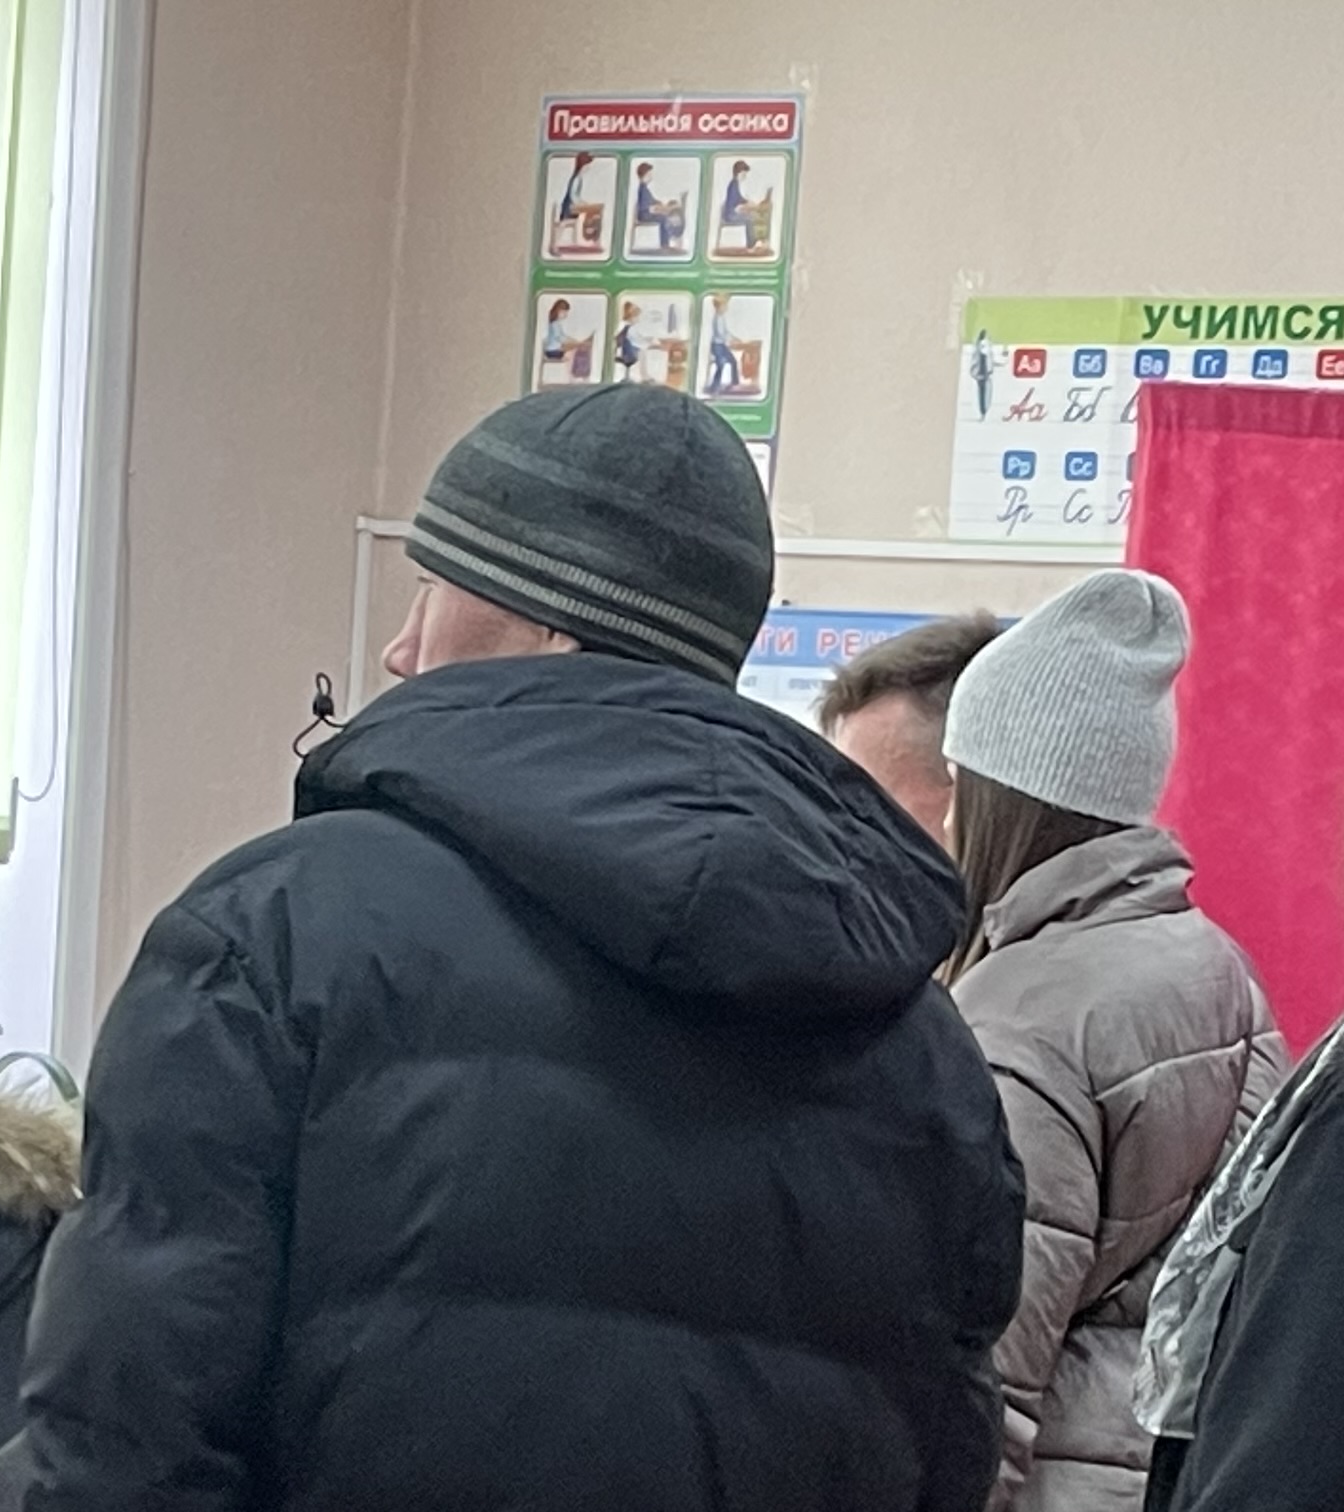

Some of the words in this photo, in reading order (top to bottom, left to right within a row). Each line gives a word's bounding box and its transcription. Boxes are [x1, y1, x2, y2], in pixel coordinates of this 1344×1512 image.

[552, 109, 692, 137] Правильная
[697, 112, 790, 133] осанка
[1016, 354, 1043, 373] Аа
[1077, 353, 1103, 373] Бб
[1138, 354, 1164, 375] Вв
[1001, 386, 1049, 423] Аа
[1062, 385, 1113, 423] Бб
[1006, 456, 1032, 478] Рр
[1068, 457, 1094, 477] Сс
[996, 485, 1035, 536] Рр
[1062, 487, 1095, 524] Сс
